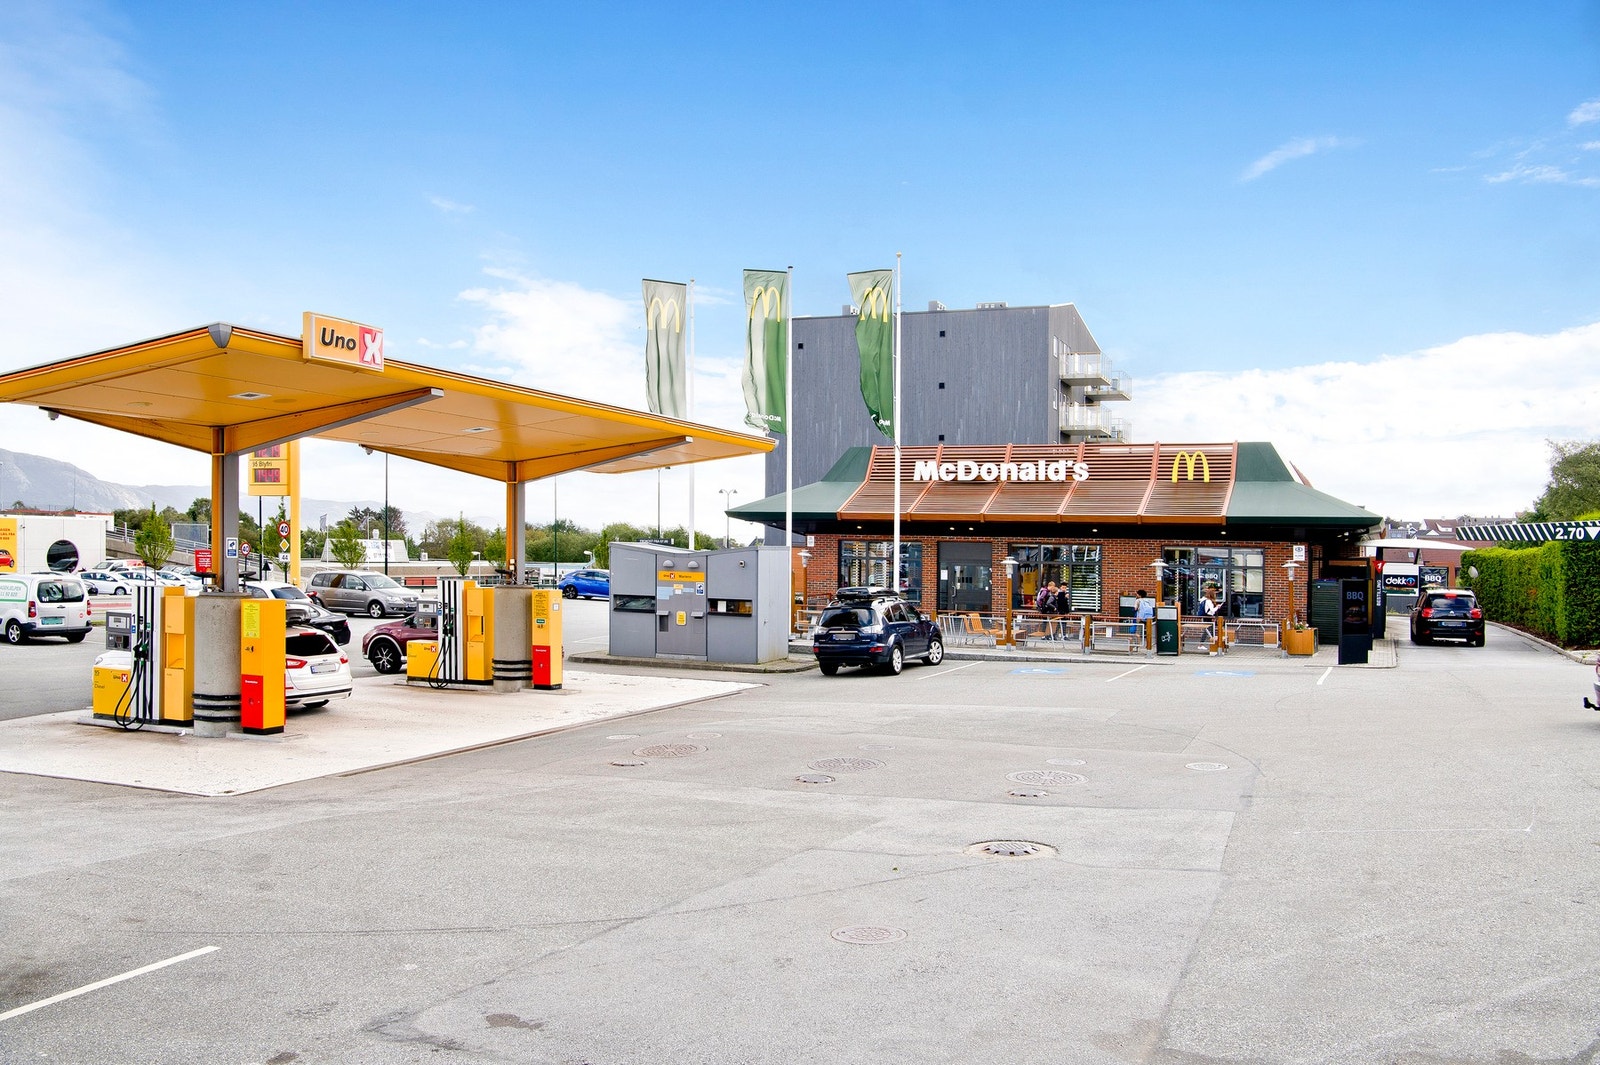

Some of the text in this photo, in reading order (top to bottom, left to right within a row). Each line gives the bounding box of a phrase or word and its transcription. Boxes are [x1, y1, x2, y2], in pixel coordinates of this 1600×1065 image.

[321, 327, 383, 365] Uno X
[913, 459, 1090, 483] McDonald's
[280, 525, 288, 534] 40
[1555, 527, 1585, 540] 2.70
[242, 545, 249, 553] 40
[1424, 574, 1442, 583] BBQ
[1346, 591, 1364, 600] BBQ
